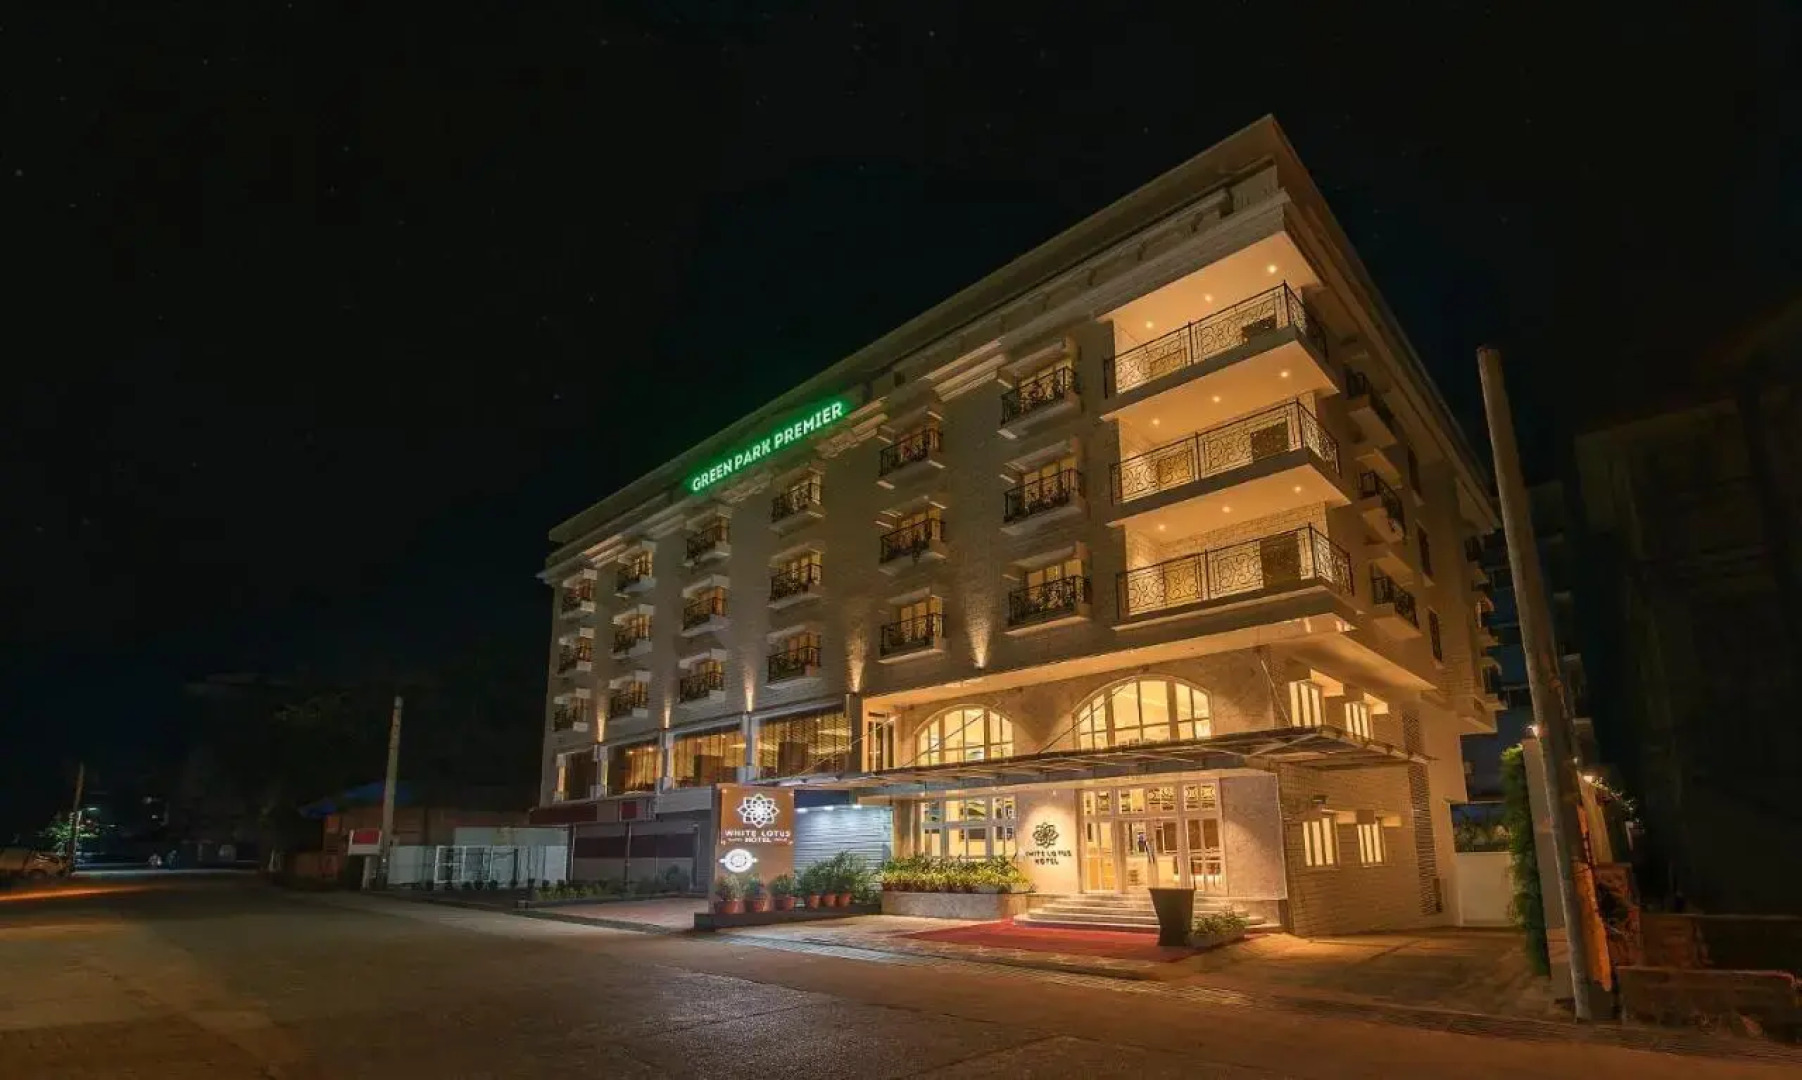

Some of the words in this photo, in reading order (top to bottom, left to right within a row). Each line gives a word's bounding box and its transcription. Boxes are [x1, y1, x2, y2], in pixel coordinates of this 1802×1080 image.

[692, 458, 733, 491] GREEN
[734, 438, 771, 470] PARK
[774, 401, 844, 449] PREMIER
